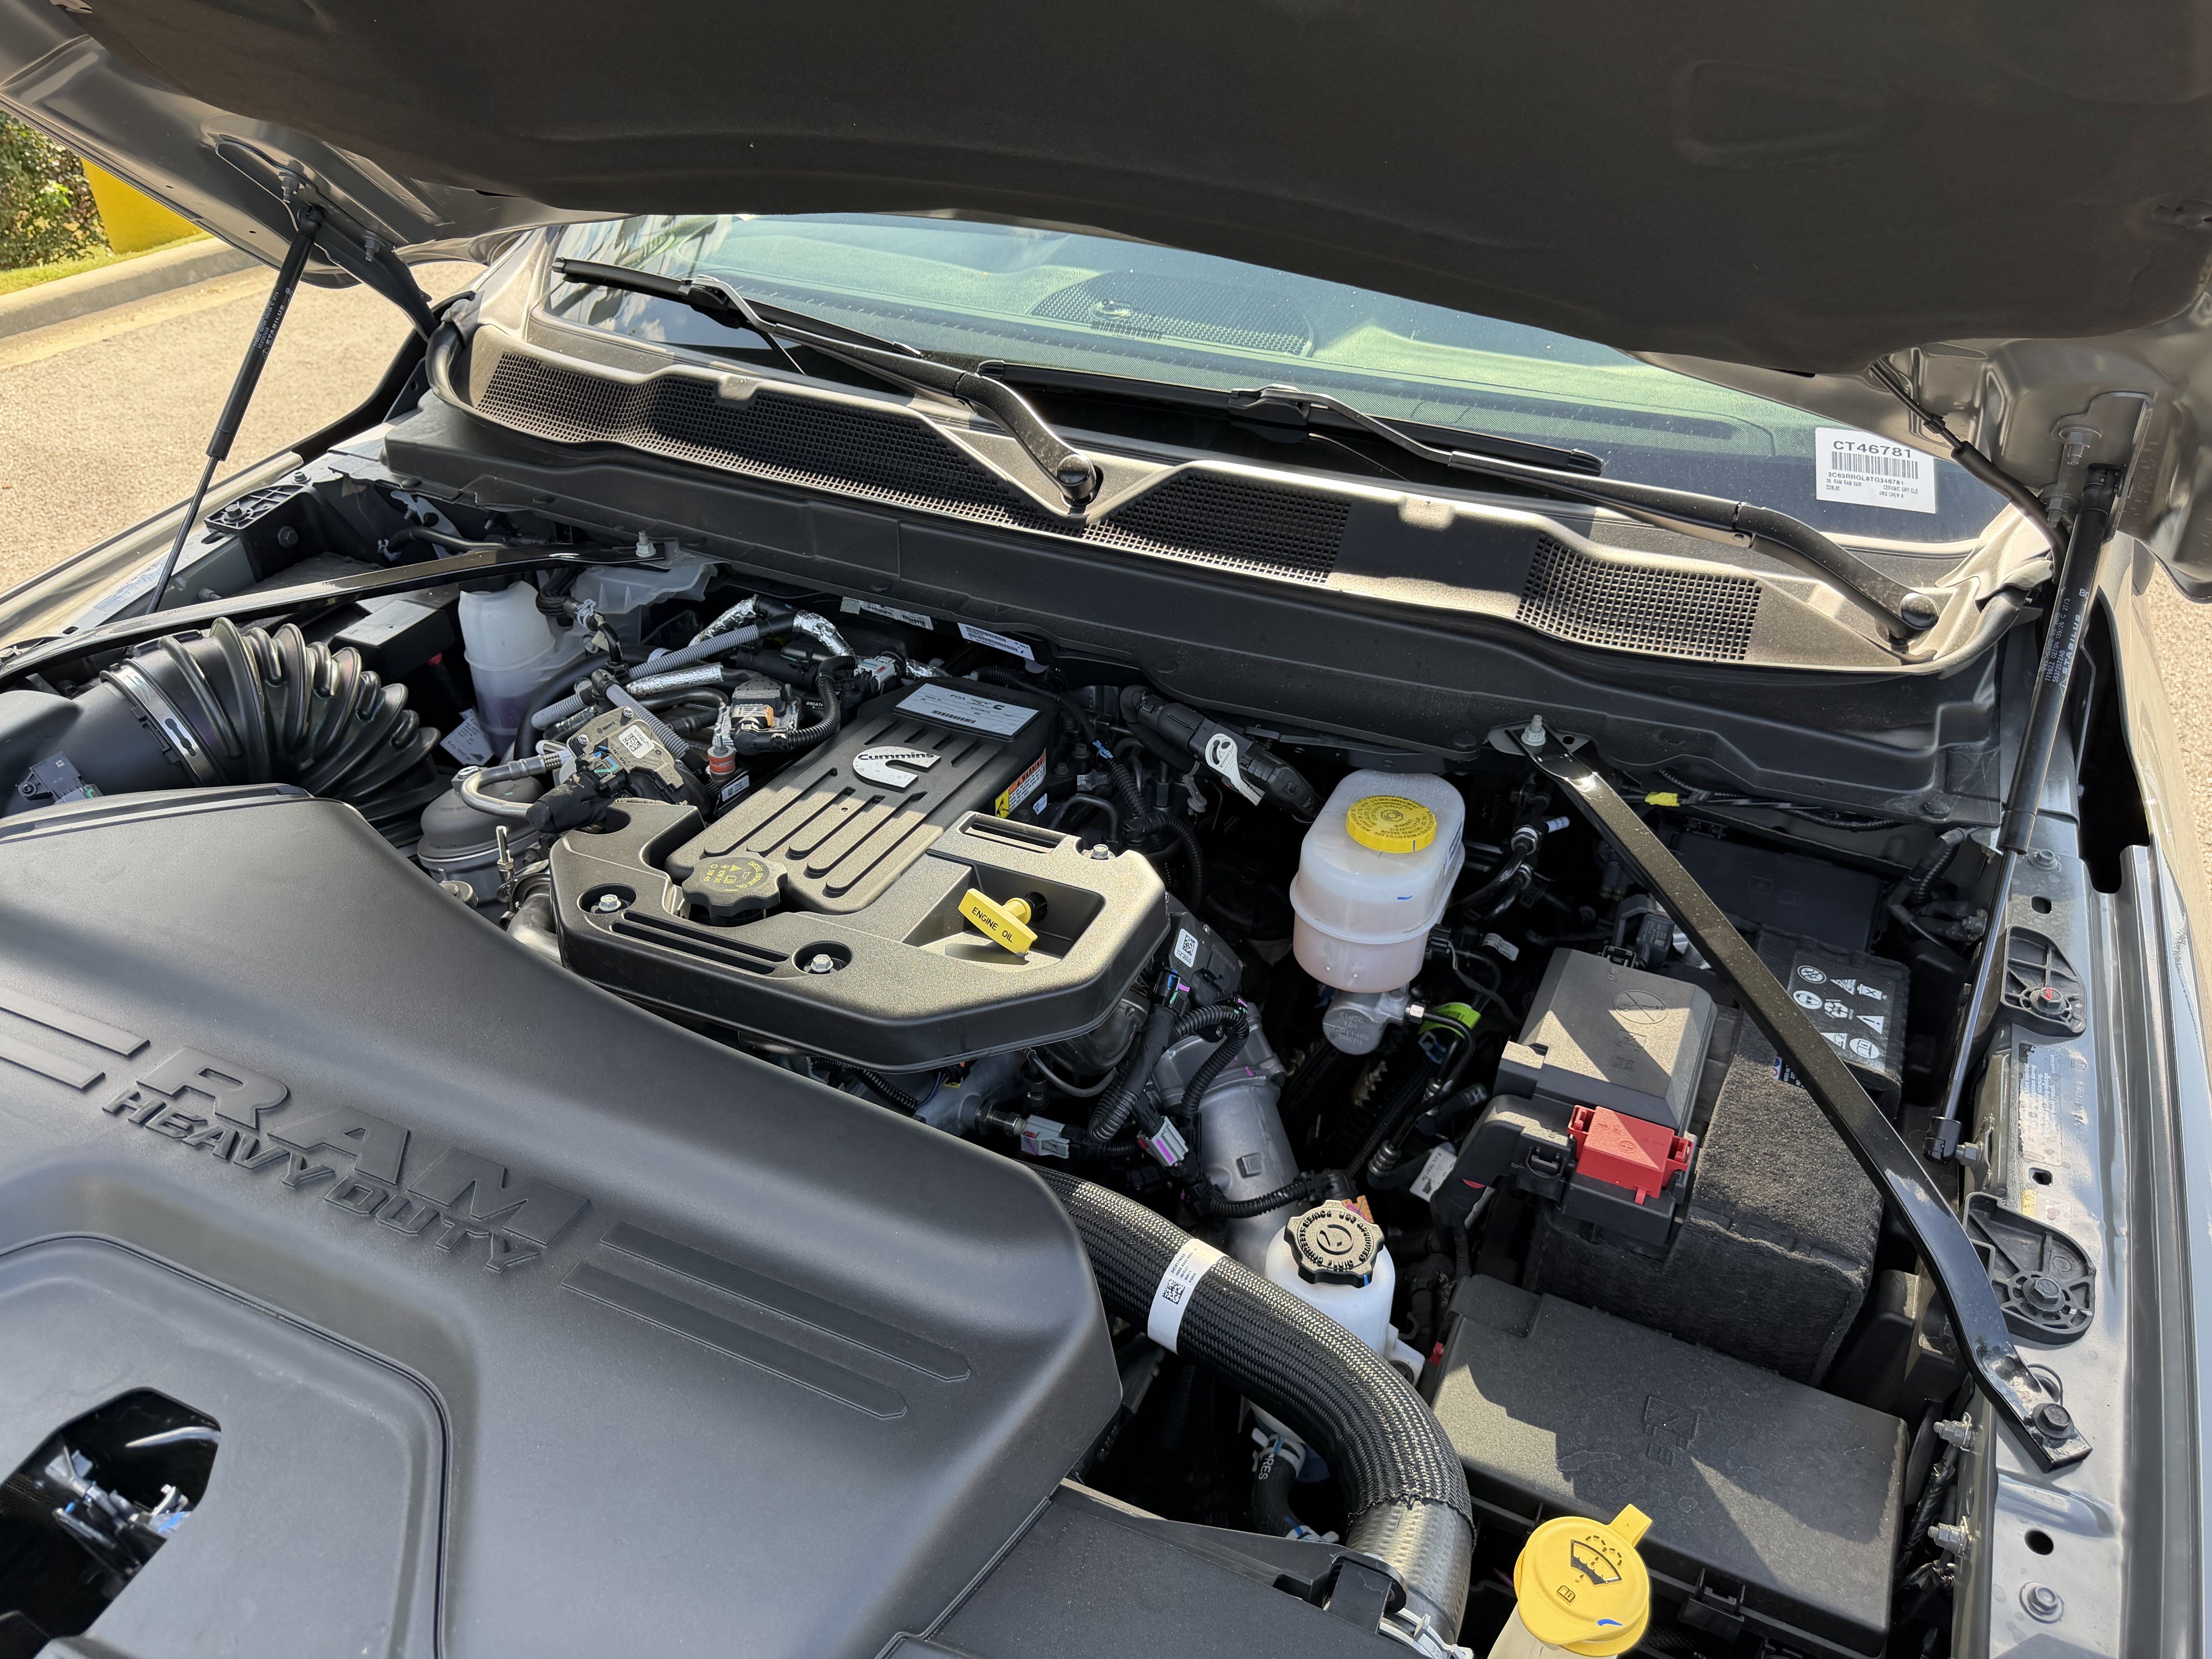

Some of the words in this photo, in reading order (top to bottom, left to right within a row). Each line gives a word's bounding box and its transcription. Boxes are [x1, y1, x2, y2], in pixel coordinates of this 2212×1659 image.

[266, 305, 284, 345] STABILUS
[1833, 441, 1910, 458] CT46781
[2055, 621, 2064, 639] 139/26
[2062, 614, 2080, 675] STABILUS
[858, 752, 934, 760] Cummins
[703, 869, 714, 881] 5W-40
[748, 861, 763, 872] DIESEL
[747, 873, 763, 886] ENGINE
[972, 907, 999, 931] ENGINE
[1002, 930, 1013, 942] OIL
[136, 1045, 589, 1246] RAM
[101, 1089, 335, 1187] HEAVY
[324, 1175, 539, 1272] DUTY
[1302, 1210, 1332, 1228] POWER
[1300, 1227, 1323, 1266] STEERING
[1339, 1211, 1357, 1224] USE
[1357, 1222, 1371, 1263] APPROVED
[1180, 1266, 1188, 1278] OUTLET
[1259, 1458, 1274, 1479] RES
